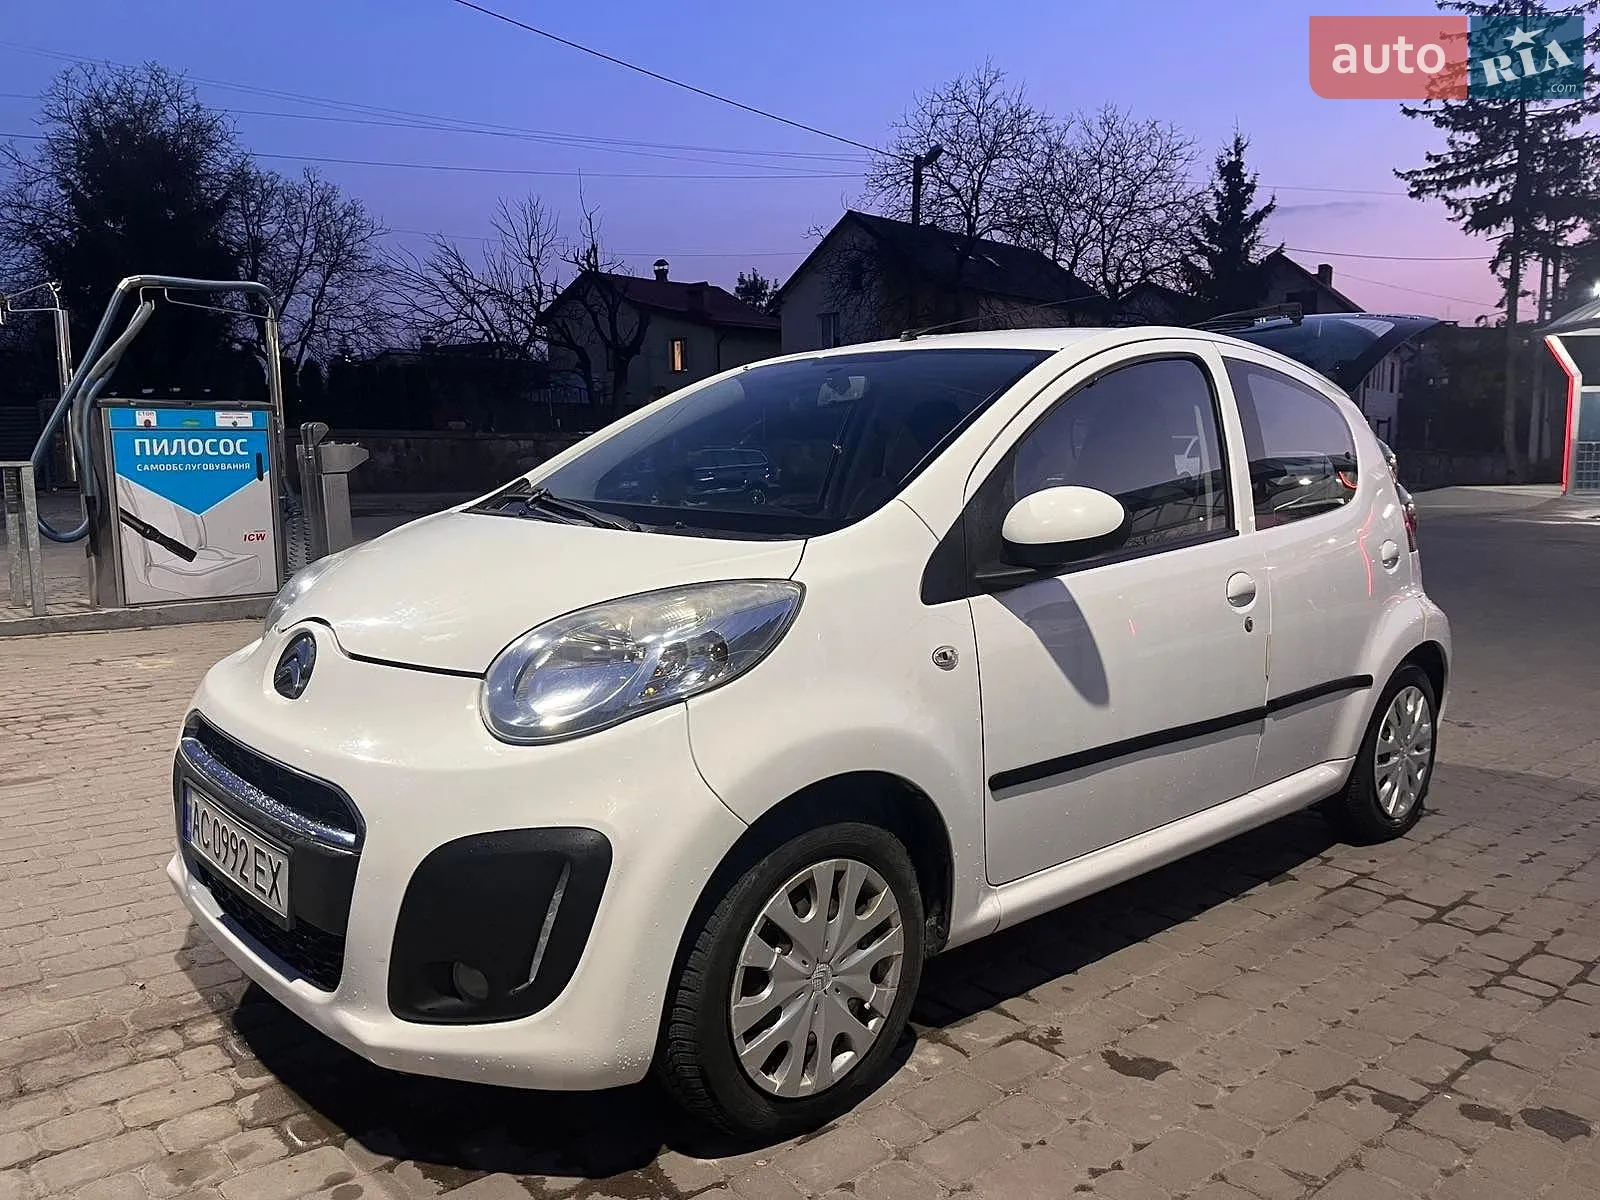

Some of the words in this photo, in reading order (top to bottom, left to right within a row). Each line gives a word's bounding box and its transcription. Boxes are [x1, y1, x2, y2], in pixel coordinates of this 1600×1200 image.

[134, 438, 249, 456] ПИЛОСОС
[136, 462, 250, 472] САМООБСЛУГОВУВАННЯ
[243, 533, 266, 542] ICW
[192, 800, 210, 848] AC
[213, 818, 249, 883] 0992
[254, 845, 282, 907] EX
